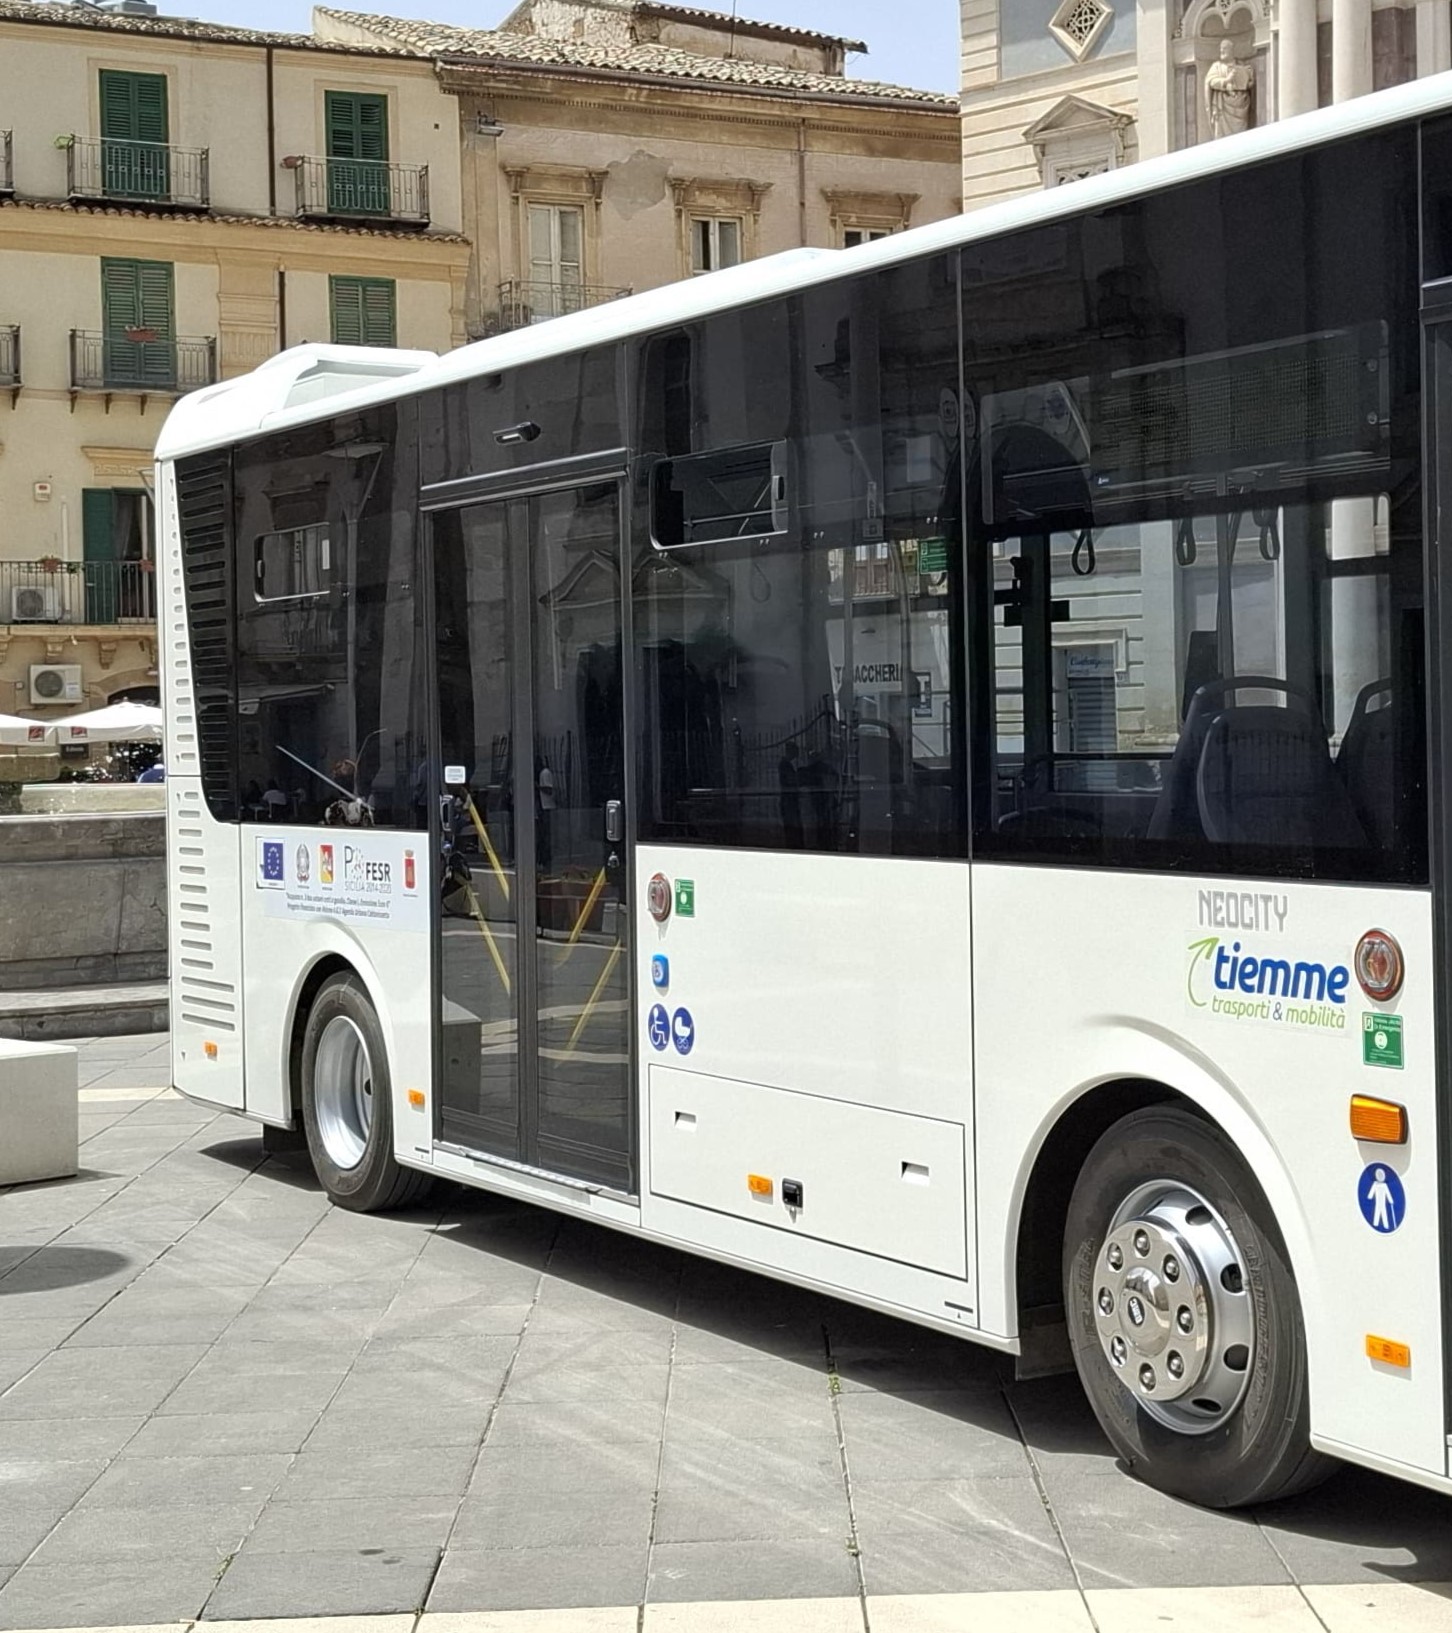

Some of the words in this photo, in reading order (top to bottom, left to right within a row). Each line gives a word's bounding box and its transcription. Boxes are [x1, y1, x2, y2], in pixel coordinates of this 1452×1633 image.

[365, 862, 391, 882] FESR
[1198, 889, 1288, 932] NEOCITY
[1214, 941, 1350, 1004] tiemme
[1212, 995, 1271, 1020] trasporti
[1272, 1001, 1283, 1021] &
[1285, 1004, 1346, 1029] mobilità
